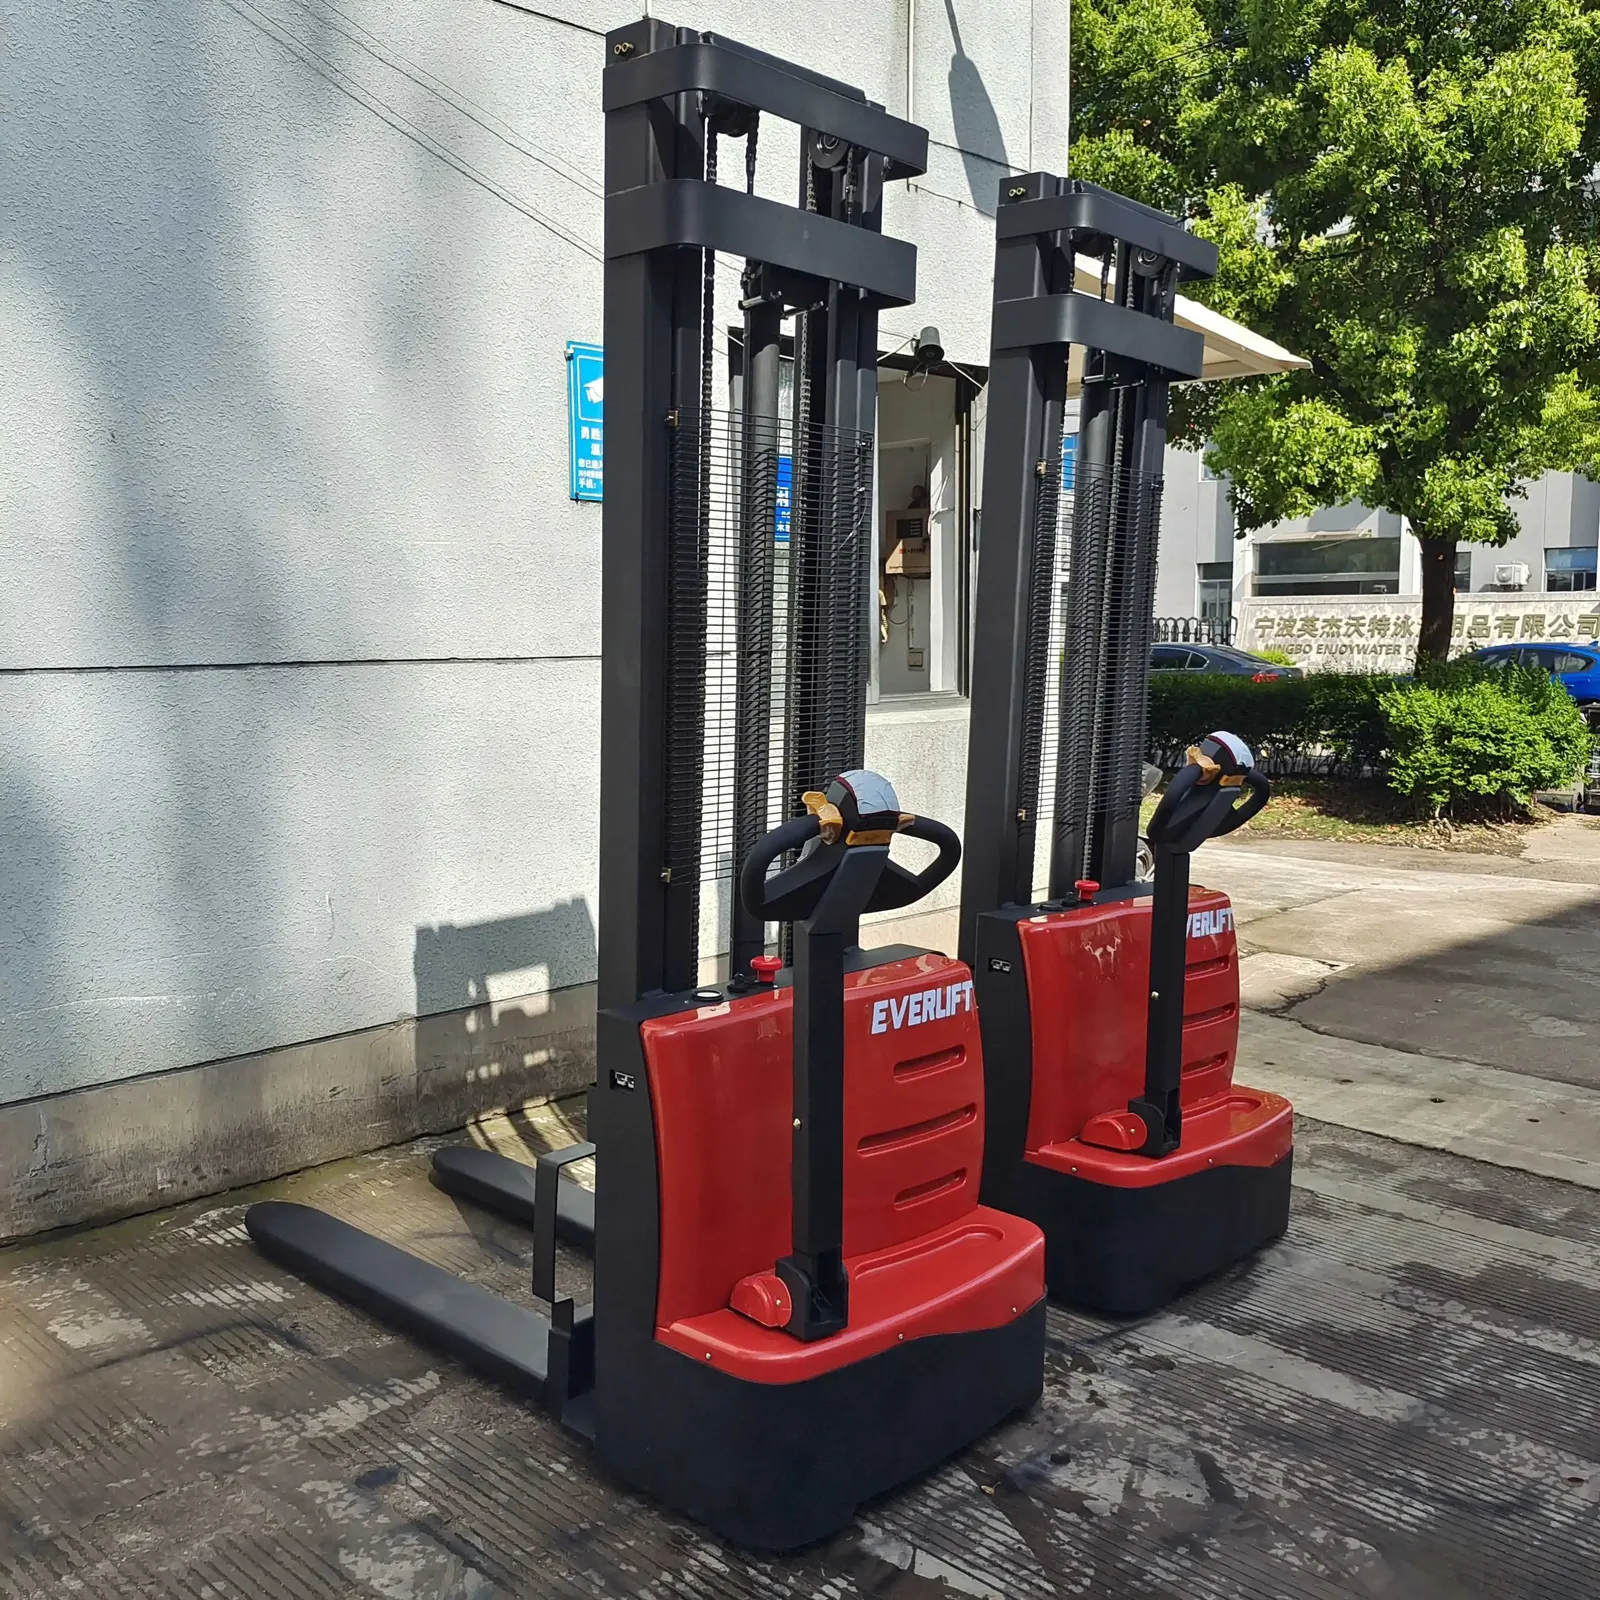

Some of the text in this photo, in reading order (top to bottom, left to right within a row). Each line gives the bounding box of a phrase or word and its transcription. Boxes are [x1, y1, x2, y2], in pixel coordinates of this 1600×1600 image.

[1254, 613, 1600, 639] 宁波英杰沃特泳用品有限公司
[1316, 643, 1402, 656] ENJOYWATER
[871, 979, 974, 1035] EVERLIFT
